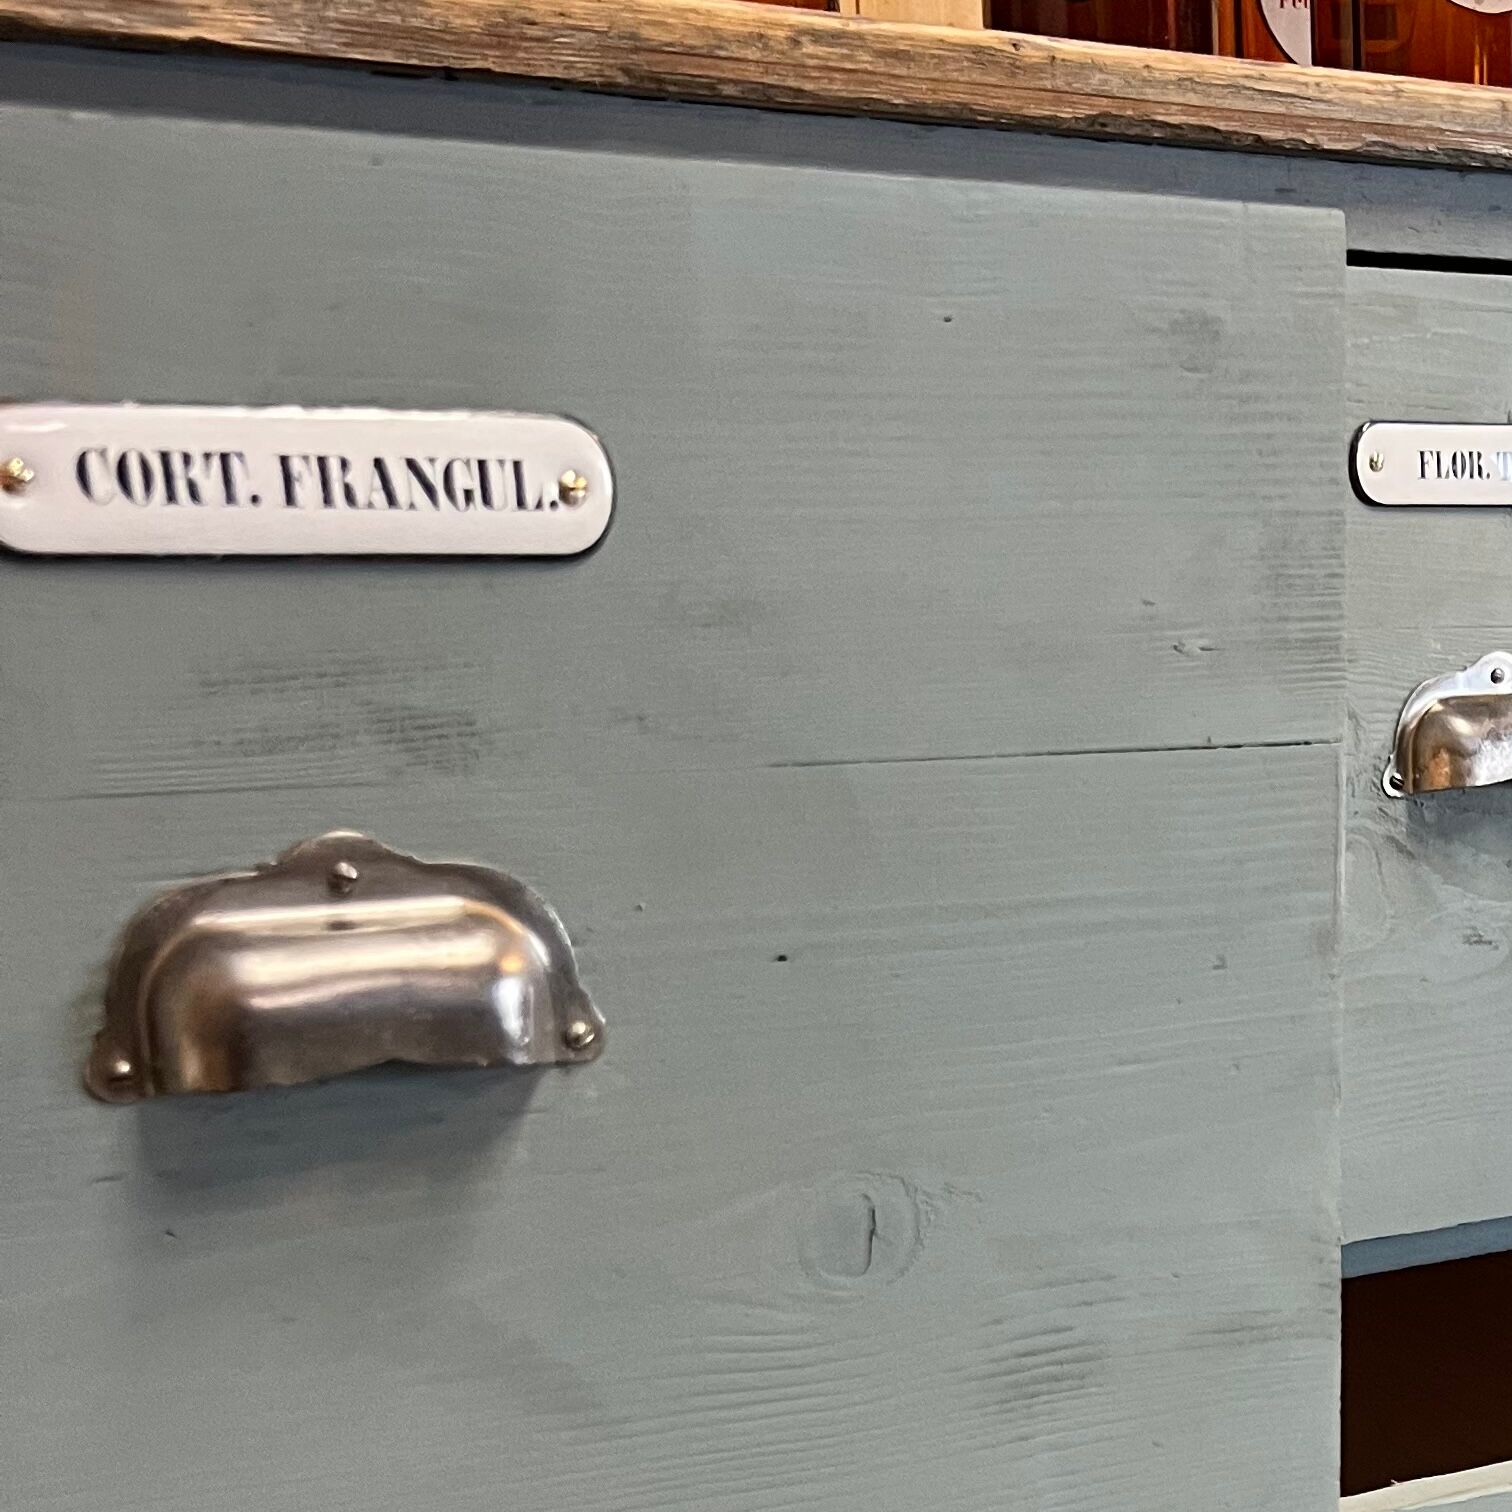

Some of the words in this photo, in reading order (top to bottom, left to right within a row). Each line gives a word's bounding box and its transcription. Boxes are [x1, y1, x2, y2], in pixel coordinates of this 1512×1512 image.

[75, 446, 260, 507] CORT.
[277, 453, 559, 512] FRANGUL.
[1417, 450, 1491, 481] FLOR.
